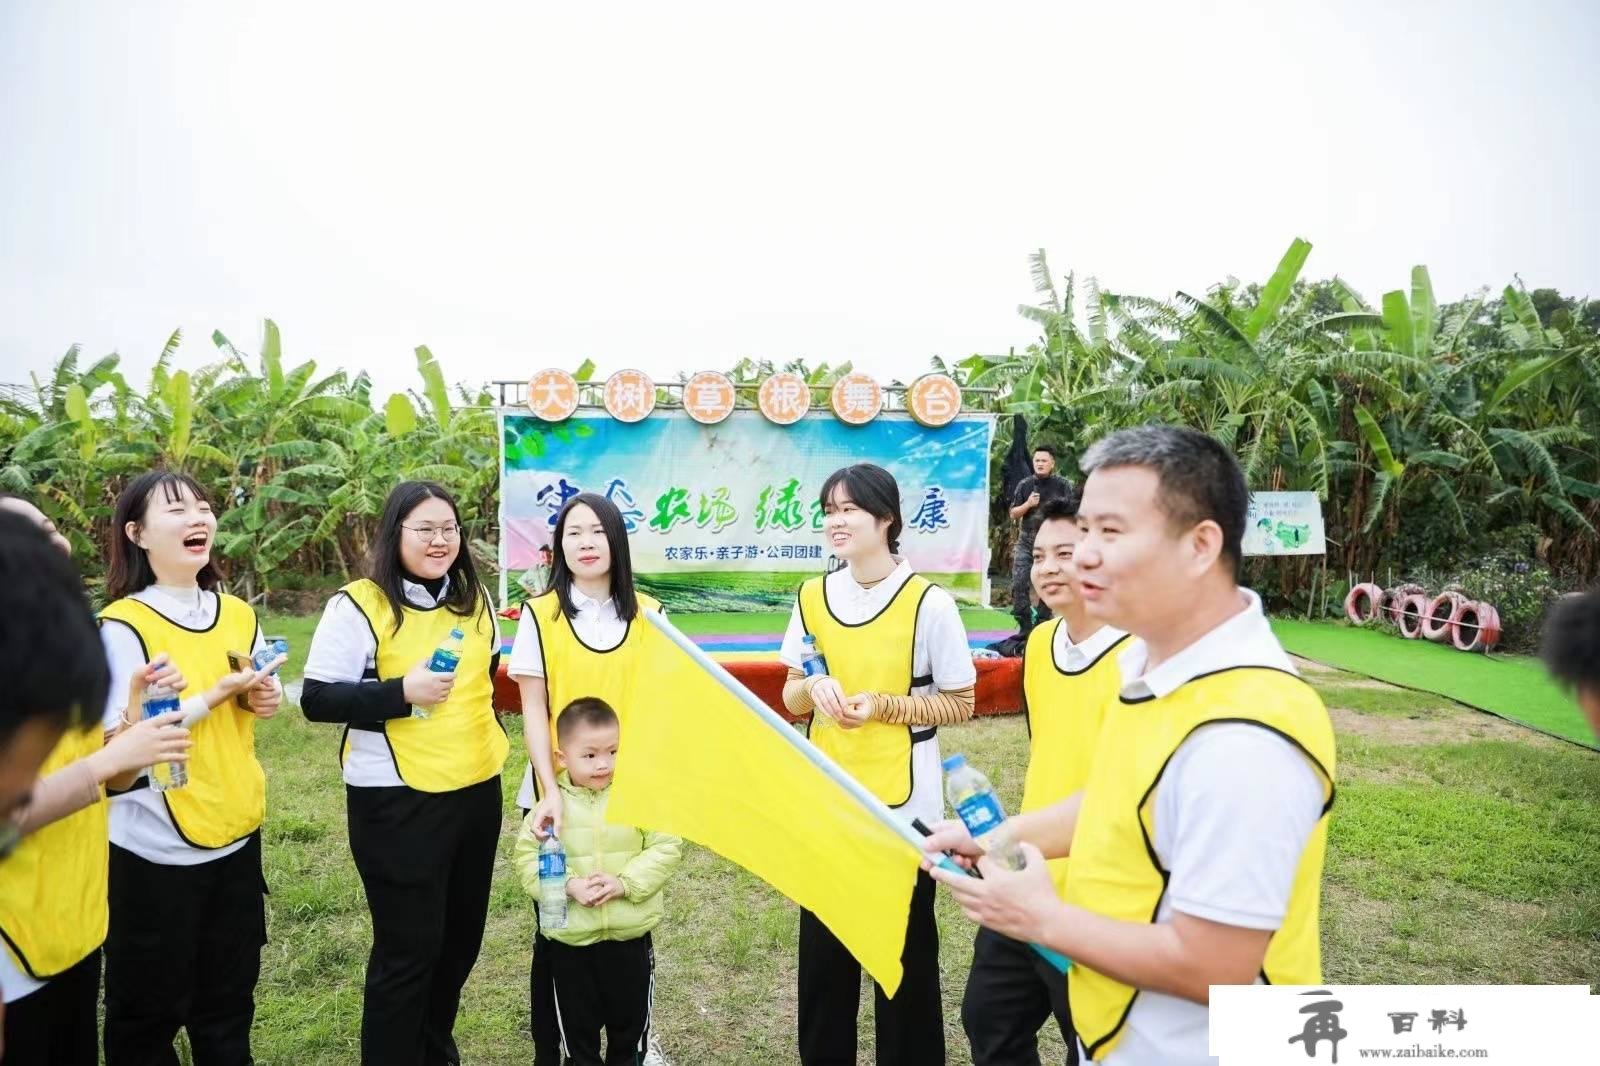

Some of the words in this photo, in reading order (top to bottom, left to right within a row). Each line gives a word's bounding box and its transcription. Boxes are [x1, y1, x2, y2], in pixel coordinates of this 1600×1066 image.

[535, 376, 951, 416] 大树草根舞台
